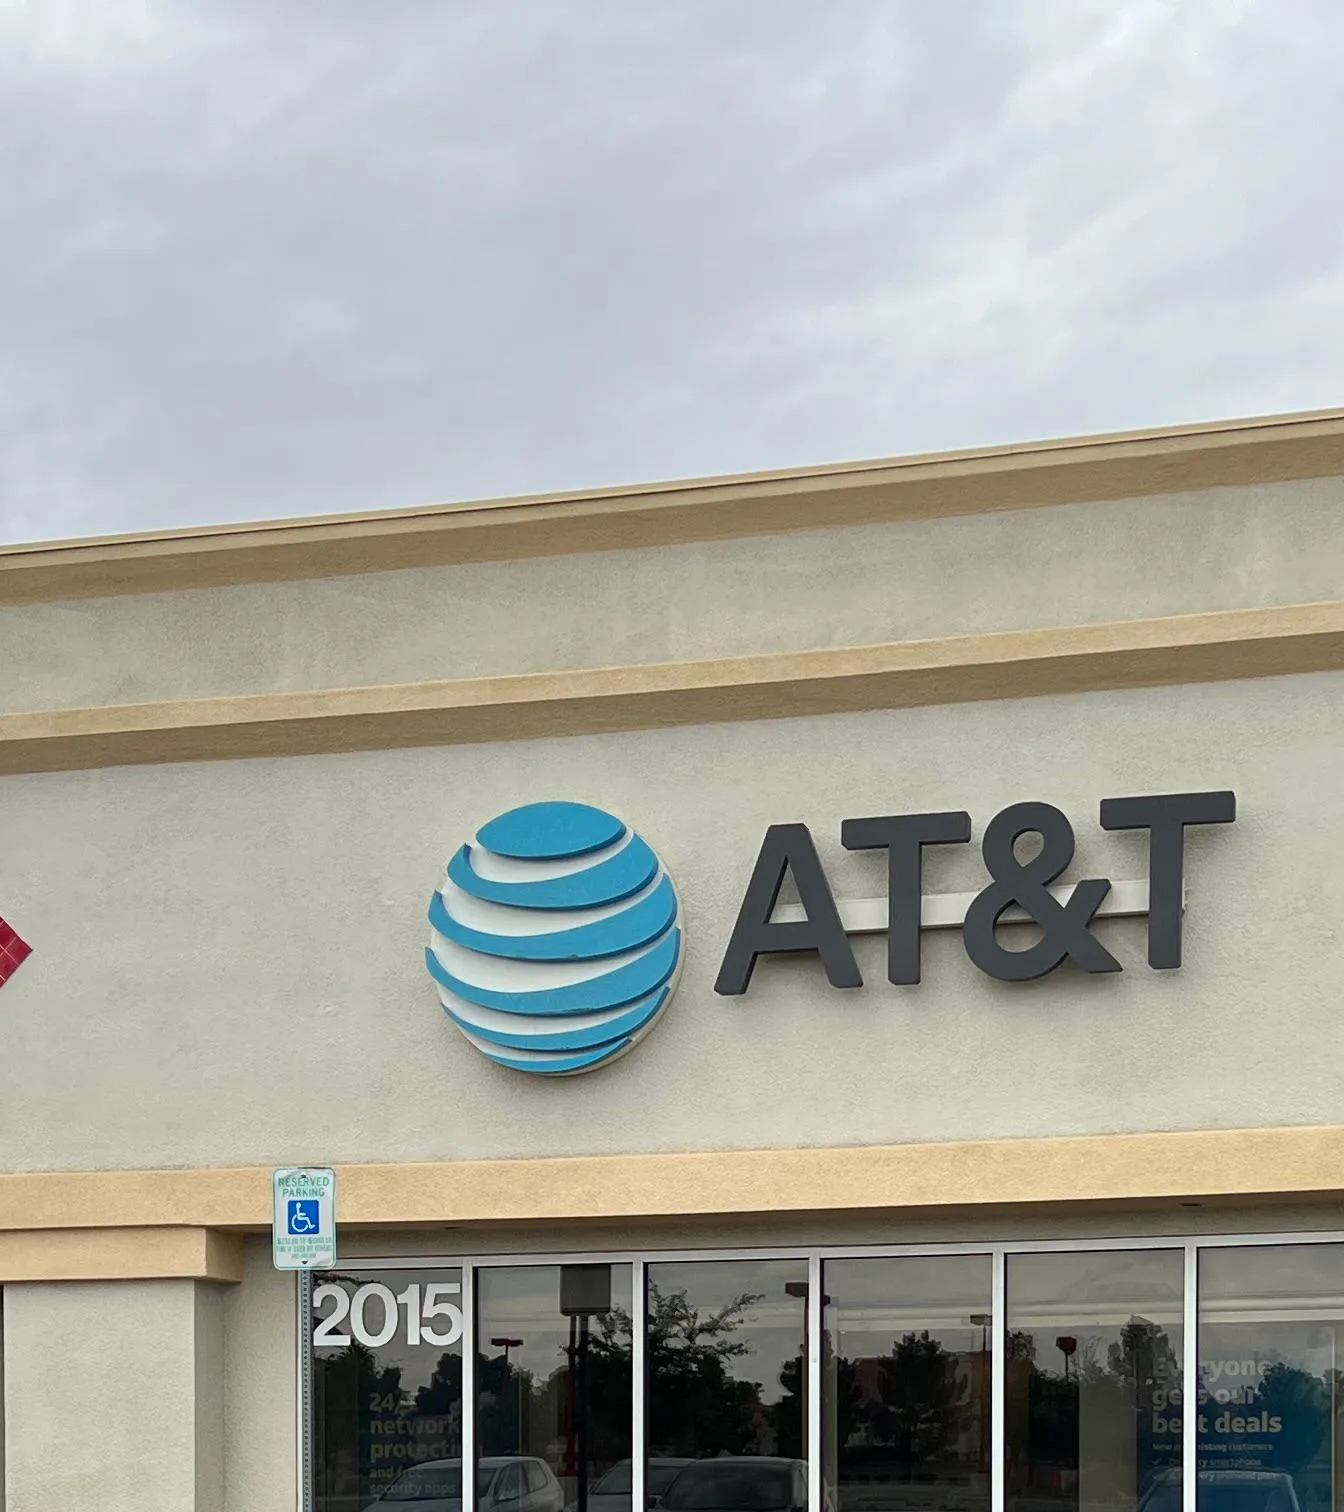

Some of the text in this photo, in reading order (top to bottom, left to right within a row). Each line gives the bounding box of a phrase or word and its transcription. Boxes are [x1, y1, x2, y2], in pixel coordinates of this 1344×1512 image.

[714, 790, 1238, 997] AT&T
[278, 1176, 330, 1188] RESERVED
[282, 1188, 325, 1197] PARKING
[313, 1282, 463, 1347] 2015
[1153, 1358, 1272, 1383] Evryone
[1152, 1388, 1207, 1411] ges
[370, 1415, 462, 1435] network
[1152, 1411, 1283, 1433] bet deals
[370, 1438, 483, 1463] protecti
[369, 1466, 393, 1478] and
